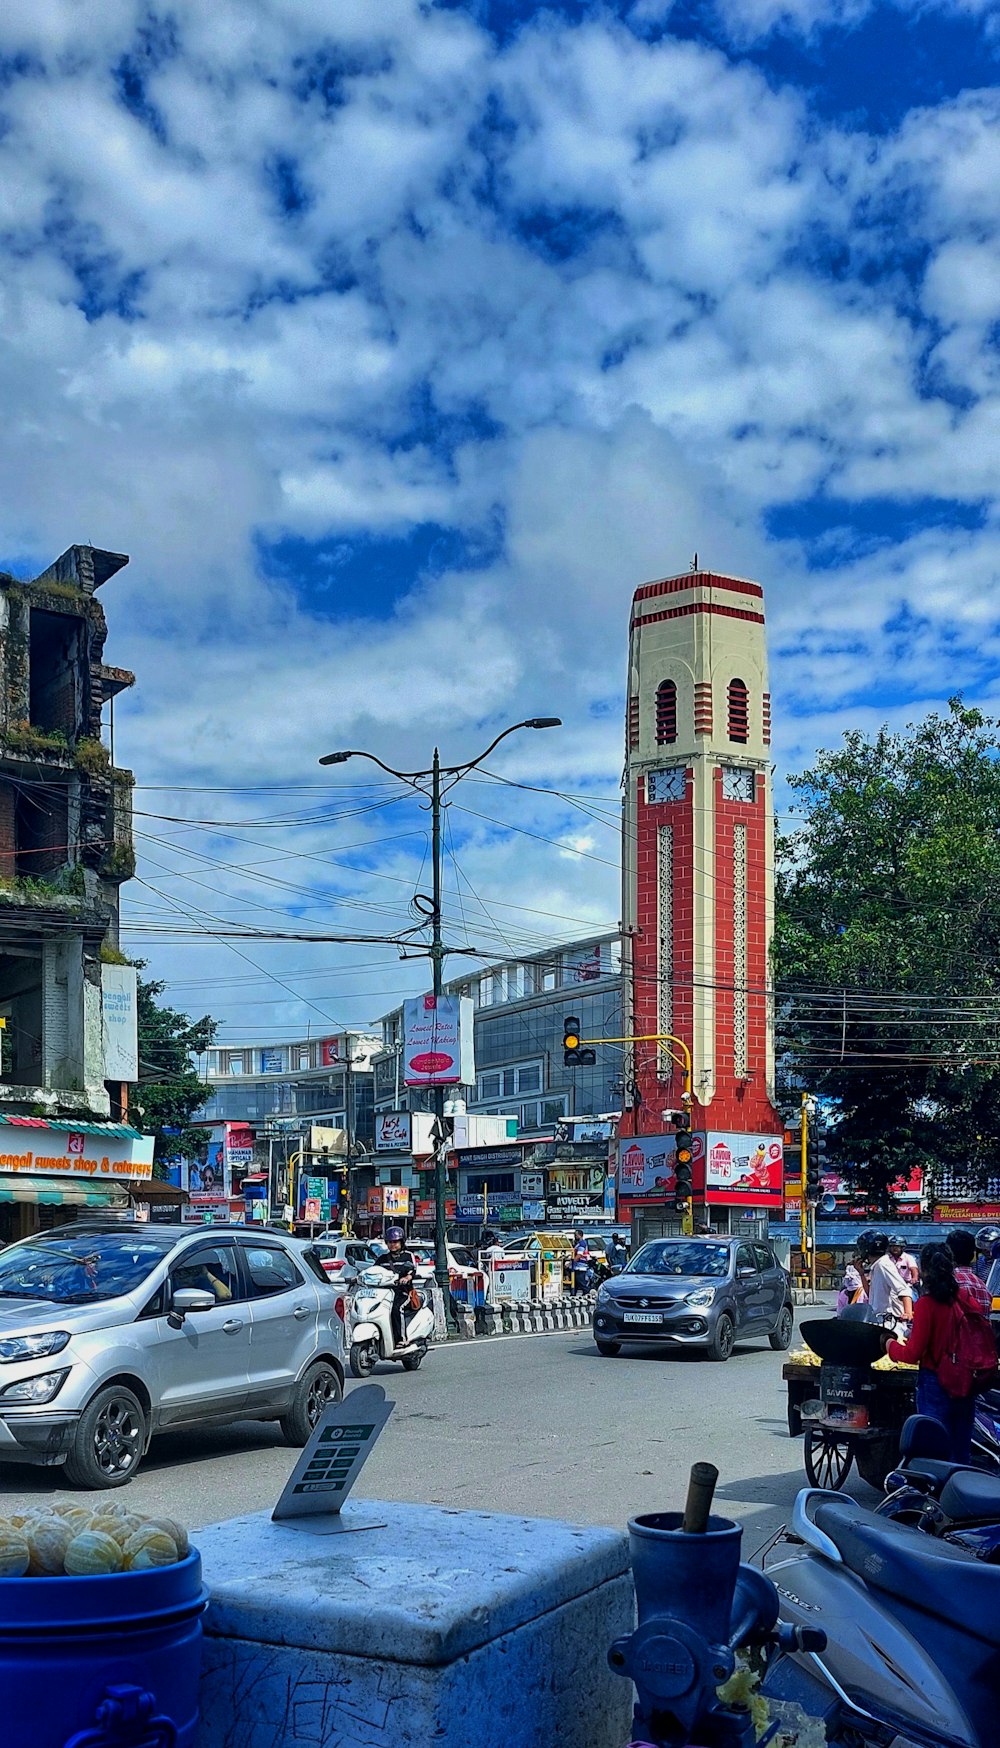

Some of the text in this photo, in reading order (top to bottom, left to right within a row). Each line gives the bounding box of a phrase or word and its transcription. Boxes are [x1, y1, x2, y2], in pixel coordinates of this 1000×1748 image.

[104, 1003, 131, 1012] sweets
[108, 1013, 127, 1025] shop
[409, 1024, 433, 1033] Lowest
[407, 1037, 430, 1046] Lowest
[379, 1115, 400, 1132] Just
[622, 1152, 644, 1167] FLAVOUR
[709, 1149, 731, 1161] FLAVOUR
[0, 1151, 151, 1176] engali sweets shop & caterers
[709, 1160, 720, 1170] FUN
[622, 1167, 633, 1178] FUN
[556, 1196, 591, 1205] NOVELTY
[546, 1205, 571, 1214] General
[826, 1388, 854, 1398] SAVITA
